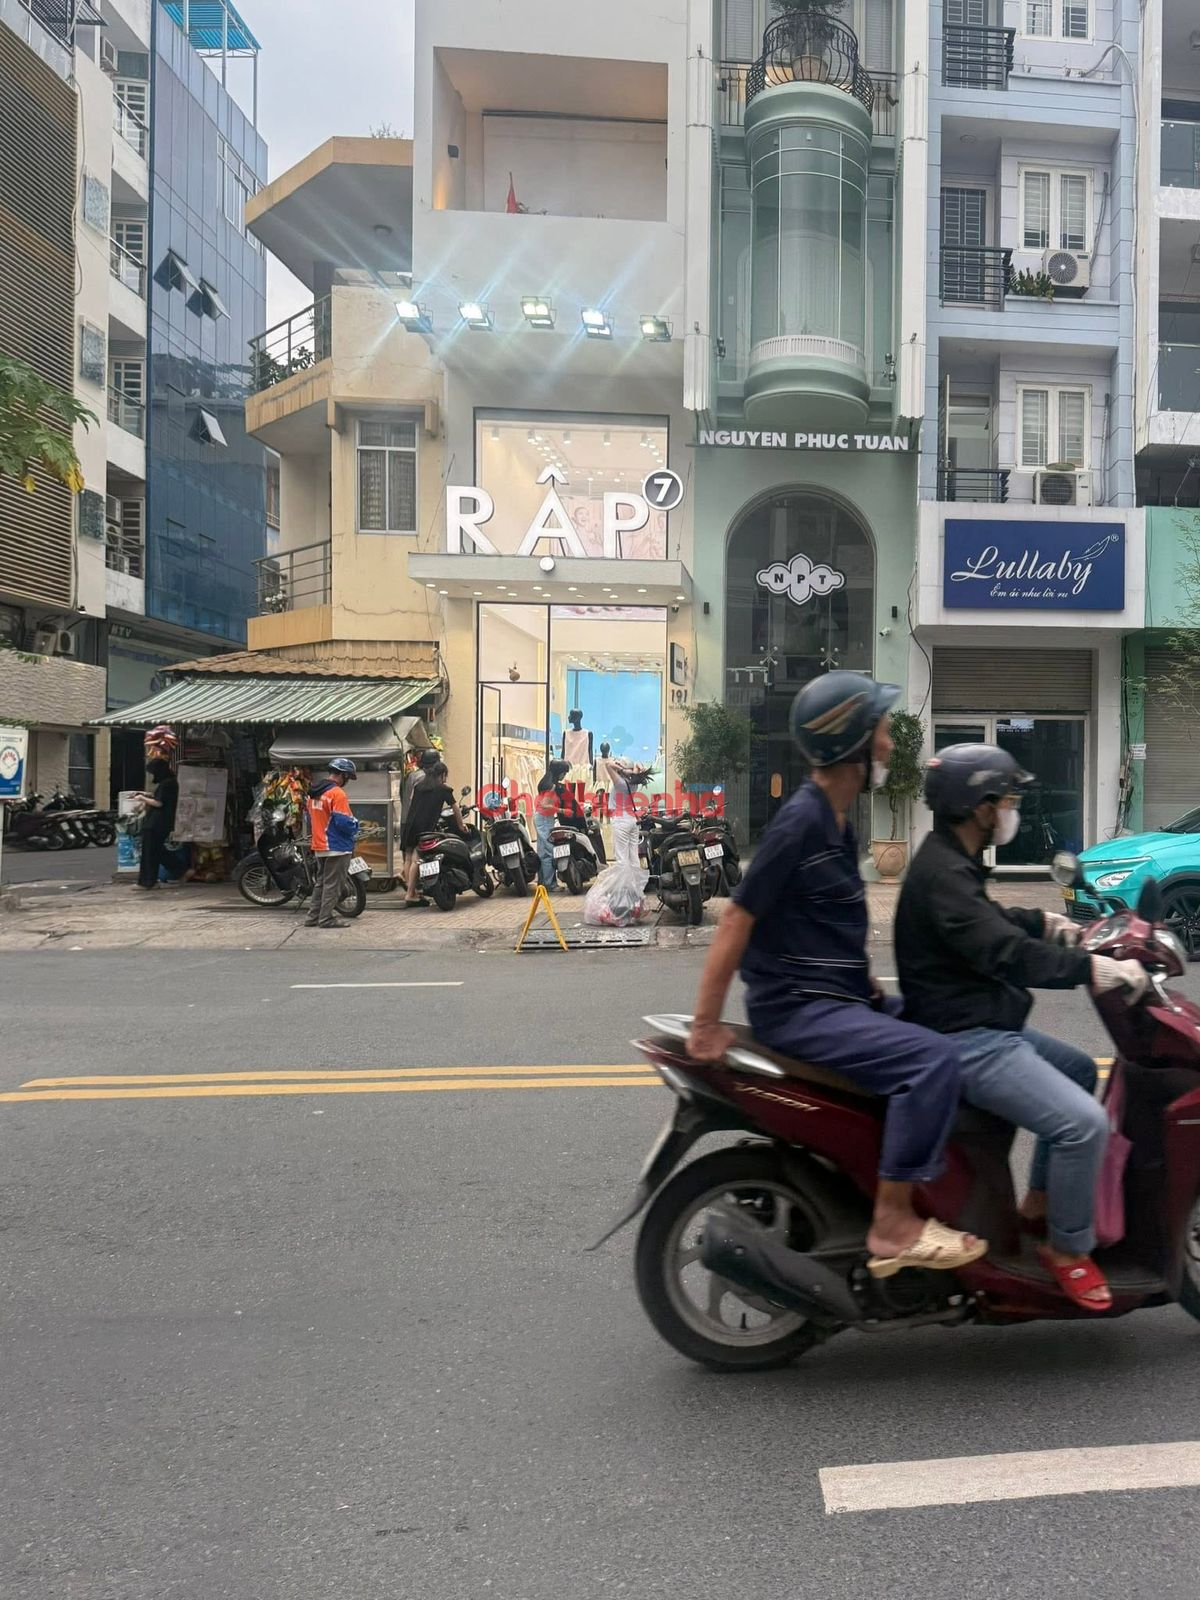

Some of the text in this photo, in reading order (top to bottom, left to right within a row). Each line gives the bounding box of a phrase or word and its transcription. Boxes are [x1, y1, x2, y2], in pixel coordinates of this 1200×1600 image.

[699, 430, 909, 450] NGUYEN PHUC TUAN
[446, 463, 650, 558] RÂP
[950, 545, 1093, 595] Lullaby
[671, 689, 688, 703] 191
